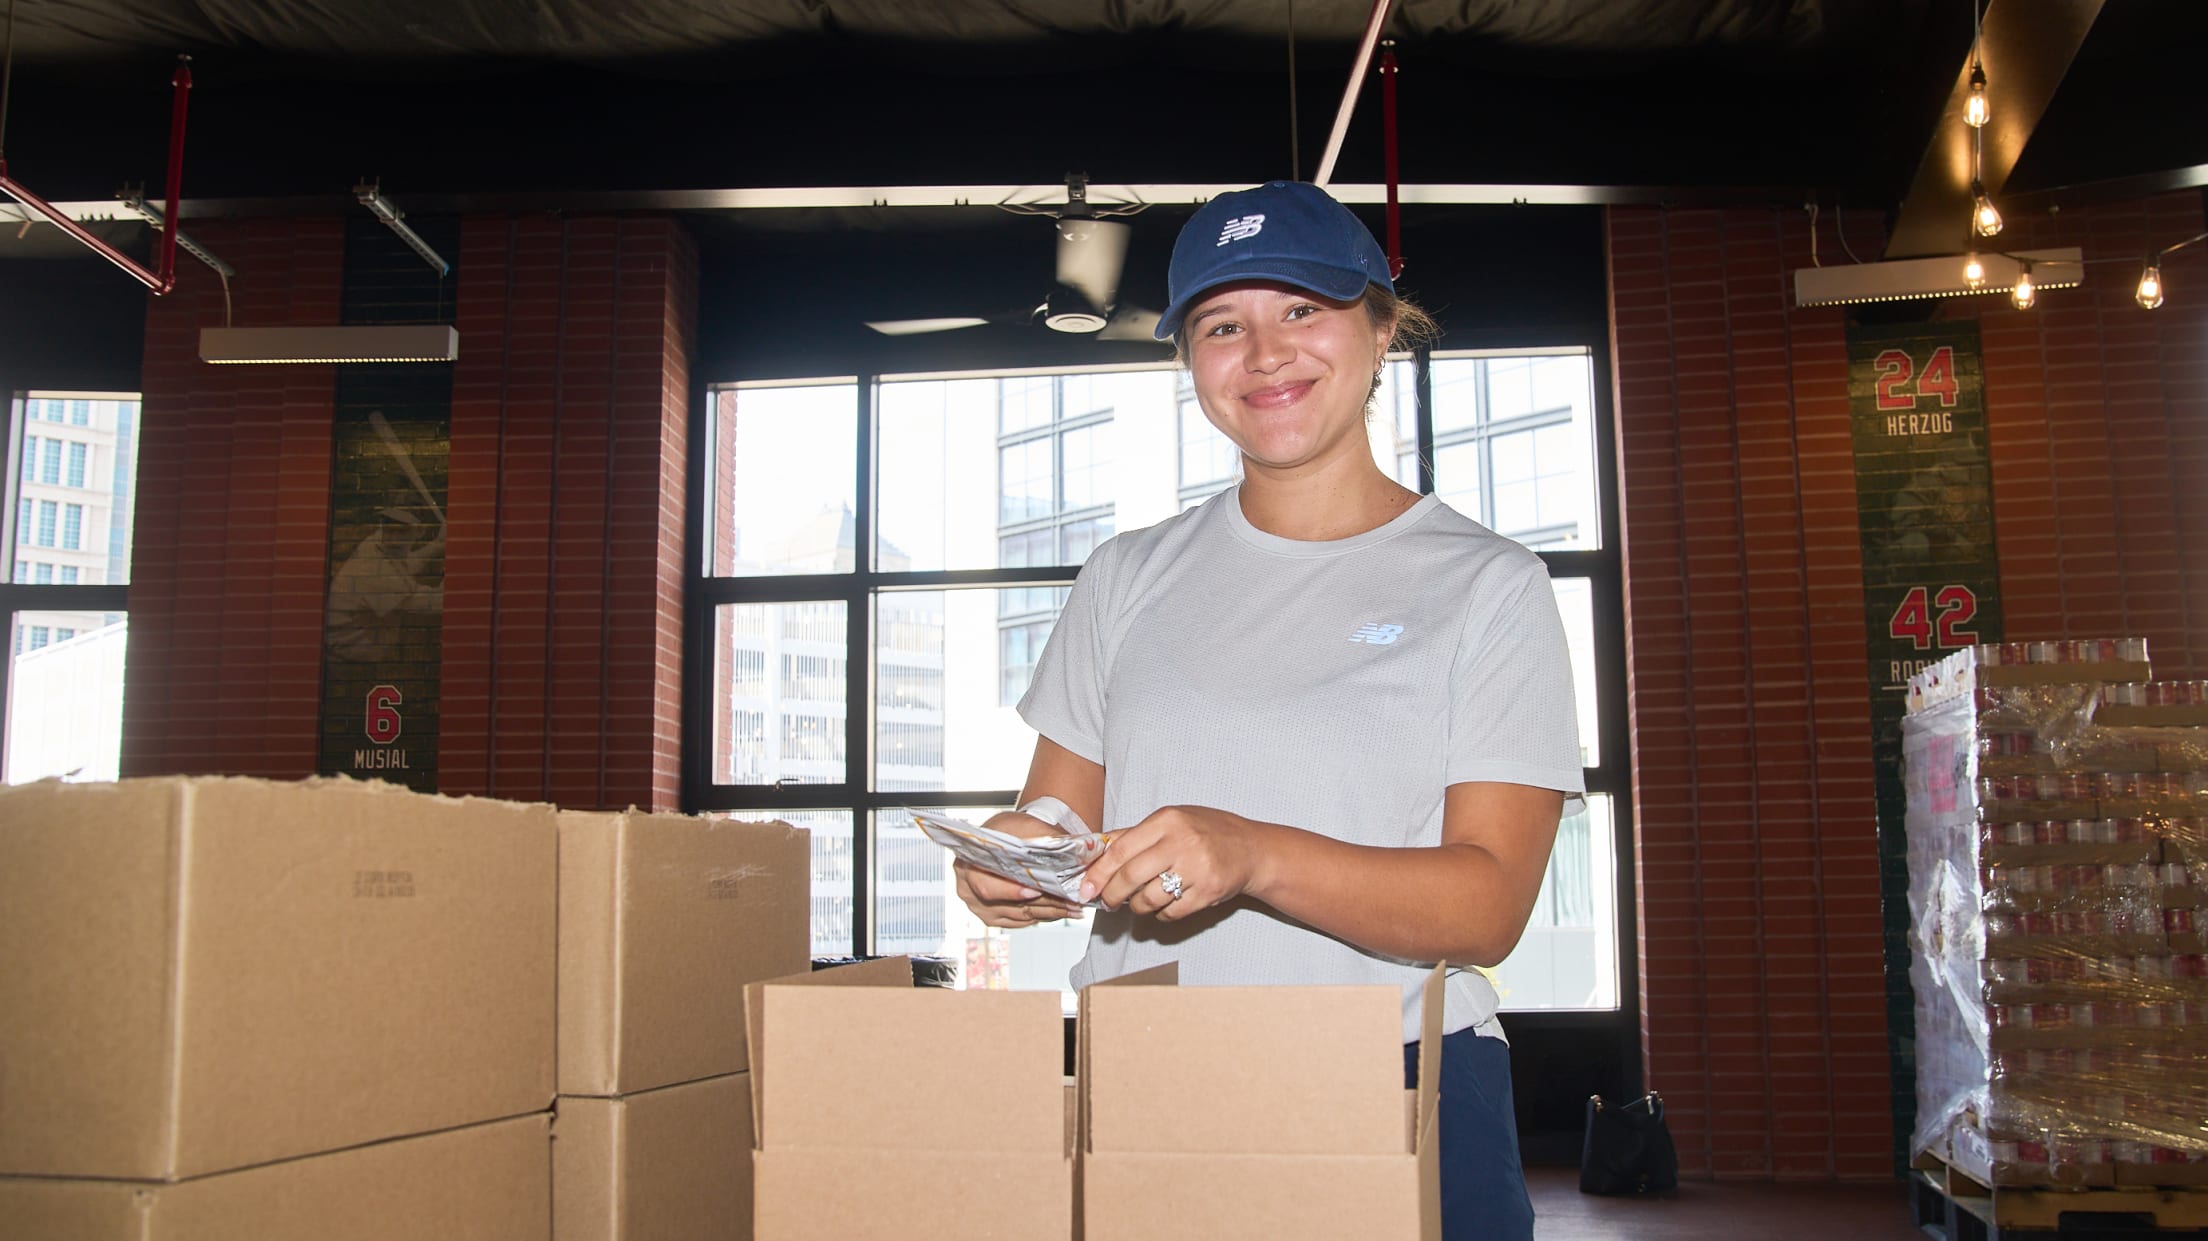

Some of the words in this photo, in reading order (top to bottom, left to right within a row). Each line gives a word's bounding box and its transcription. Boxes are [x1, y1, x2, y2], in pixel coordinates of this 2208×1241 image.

[1216, 213, 1266, 247] NB
[1874, 346, 1960, 411] 24
[1886, 413, 1953, 436] HERZOG
[1889, 585, 1979, 650] 42
[1346, 622, 1404, 645] NB
[1890, 660, 1940, 683] ROB
[365, 684, 402, 744] 6
[354, 749, 410, 769] MUSIAL
